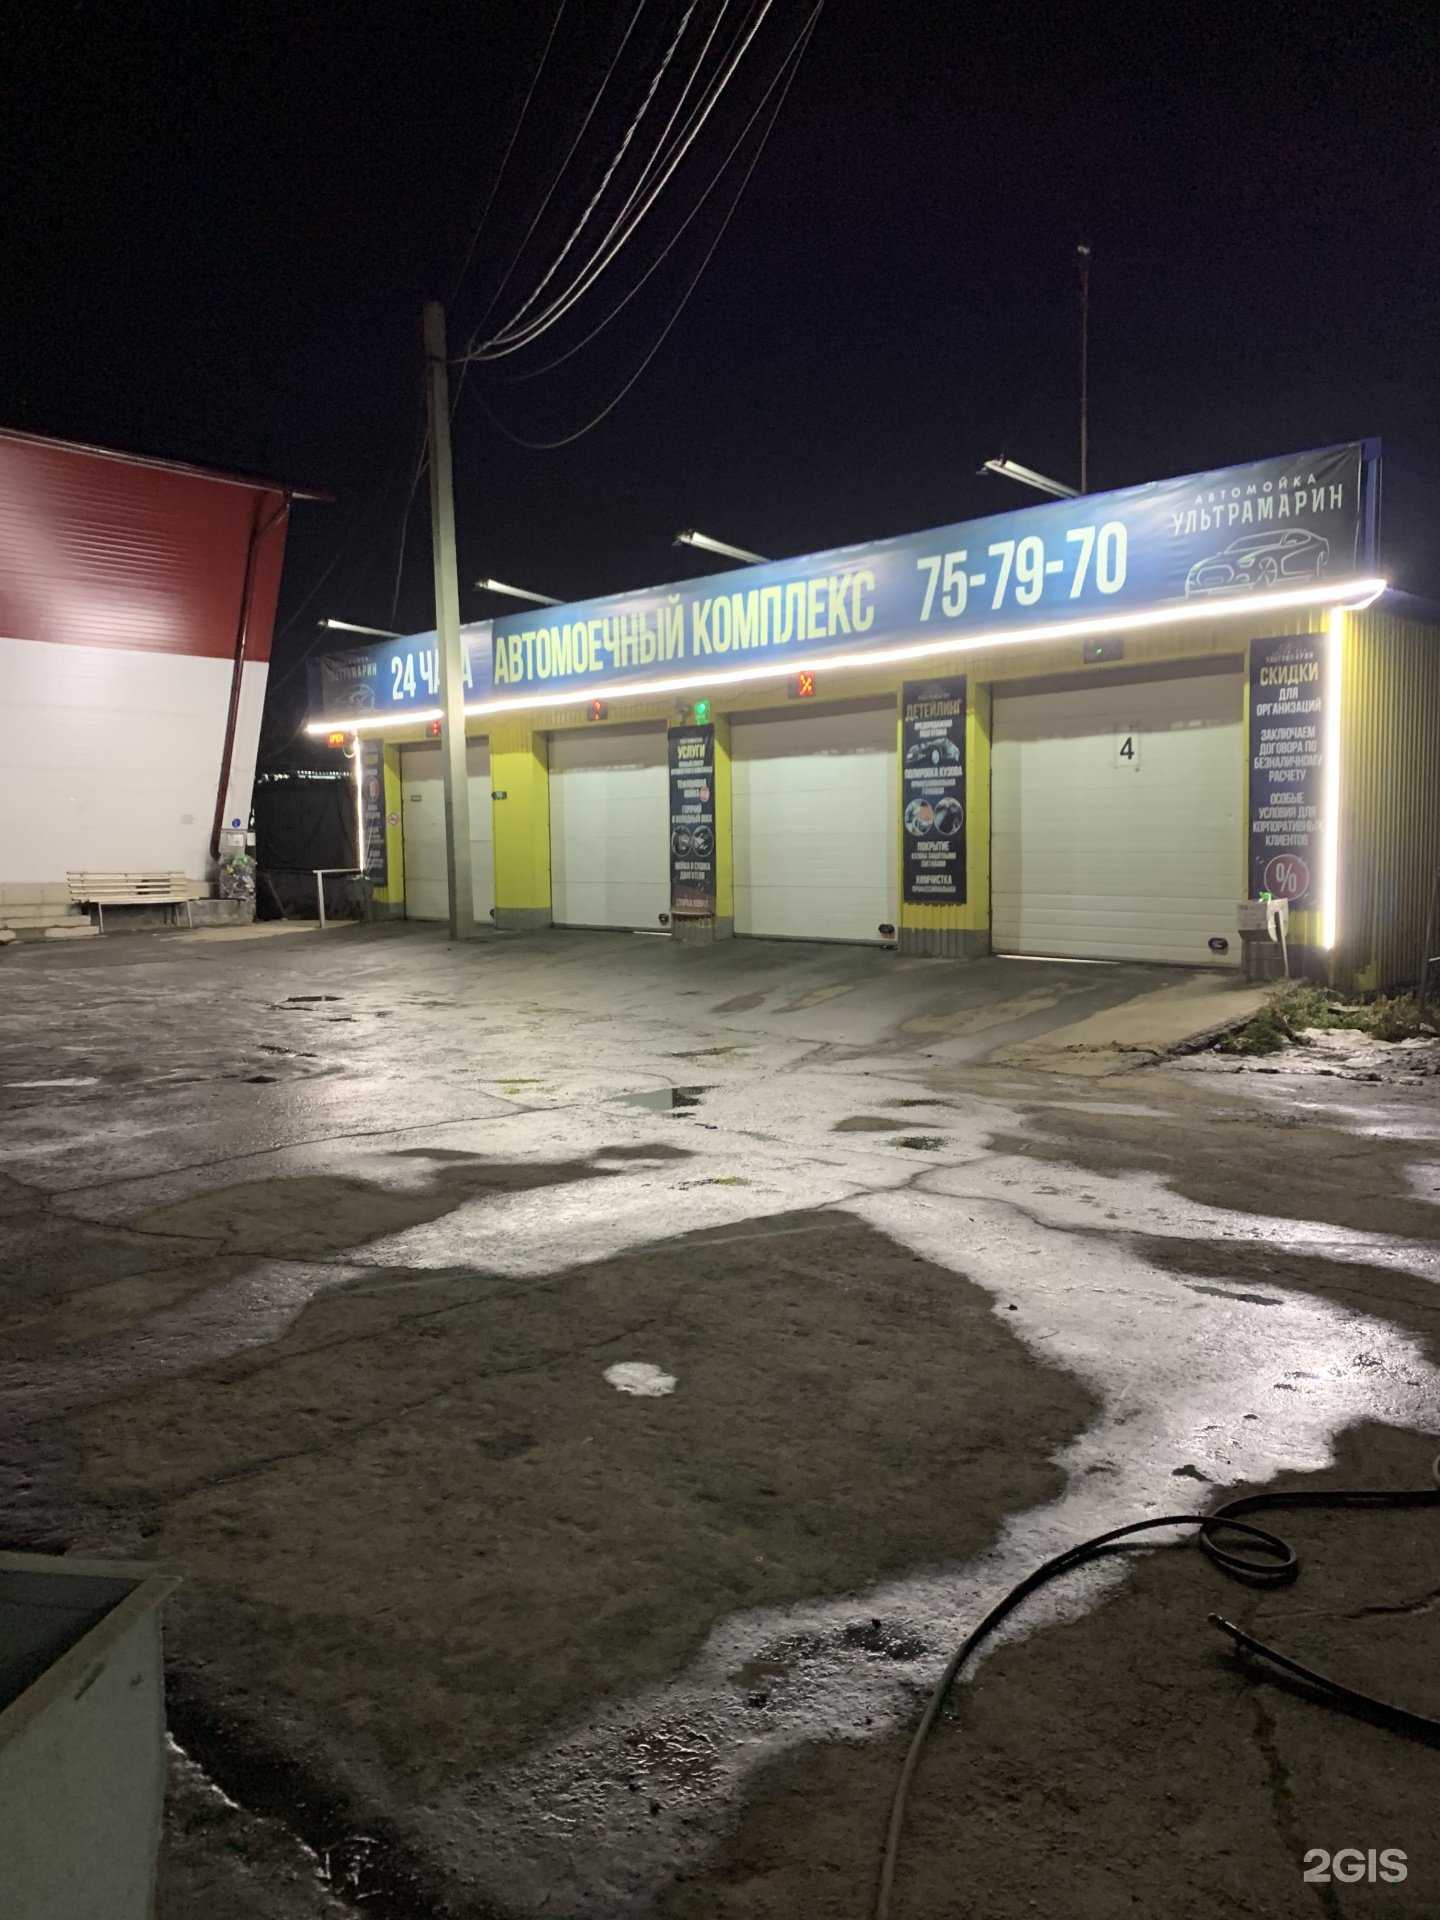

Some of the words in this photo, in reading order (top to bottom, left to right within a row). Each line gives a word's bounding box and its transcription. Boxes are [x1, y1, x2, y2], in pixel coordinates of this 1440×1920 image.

[1195, 473, 1316, 505] АВТОМОЙКА
[1173, 484, 1342, 536] УЛЬТРАМАРИН
[917, 521, 1127, 621] 75-79-70
[495, 593, 684, 685] АВТОМОЕЧНЫЙ
[692, 570, 875, 656] КОМПЛЕКС
[391, 653, 416, 700] 24
[419, 649, 473, 694] ЧАА
[1260, 662, 1319, 686] СКИДКИ
[1279, 687, 1299, 701] ДЛЯ
[905, 699, 961, 721] ДЕТЕЙЛИНГ
[1257, 698, 1322, 716] ОРГАНИЗАЦИЙ
[1261, 727, 1316, 741] ЗАКЛЮЧАЕМ
[677, 744, 705, 759] УСЛУГИ
[1120, 736, 1135, 760] 4
[1259, 741, 1303, 756] ДОГОВОРА
[1305, 740, 1317, 753] ПО
[1269, 769, 1306, 782] РАСЧЕТУ
[1270, 792, 1304, 805] ОСОБЫЕ
[1266, 834, 1309, 846] КЛИЕНТОВ
